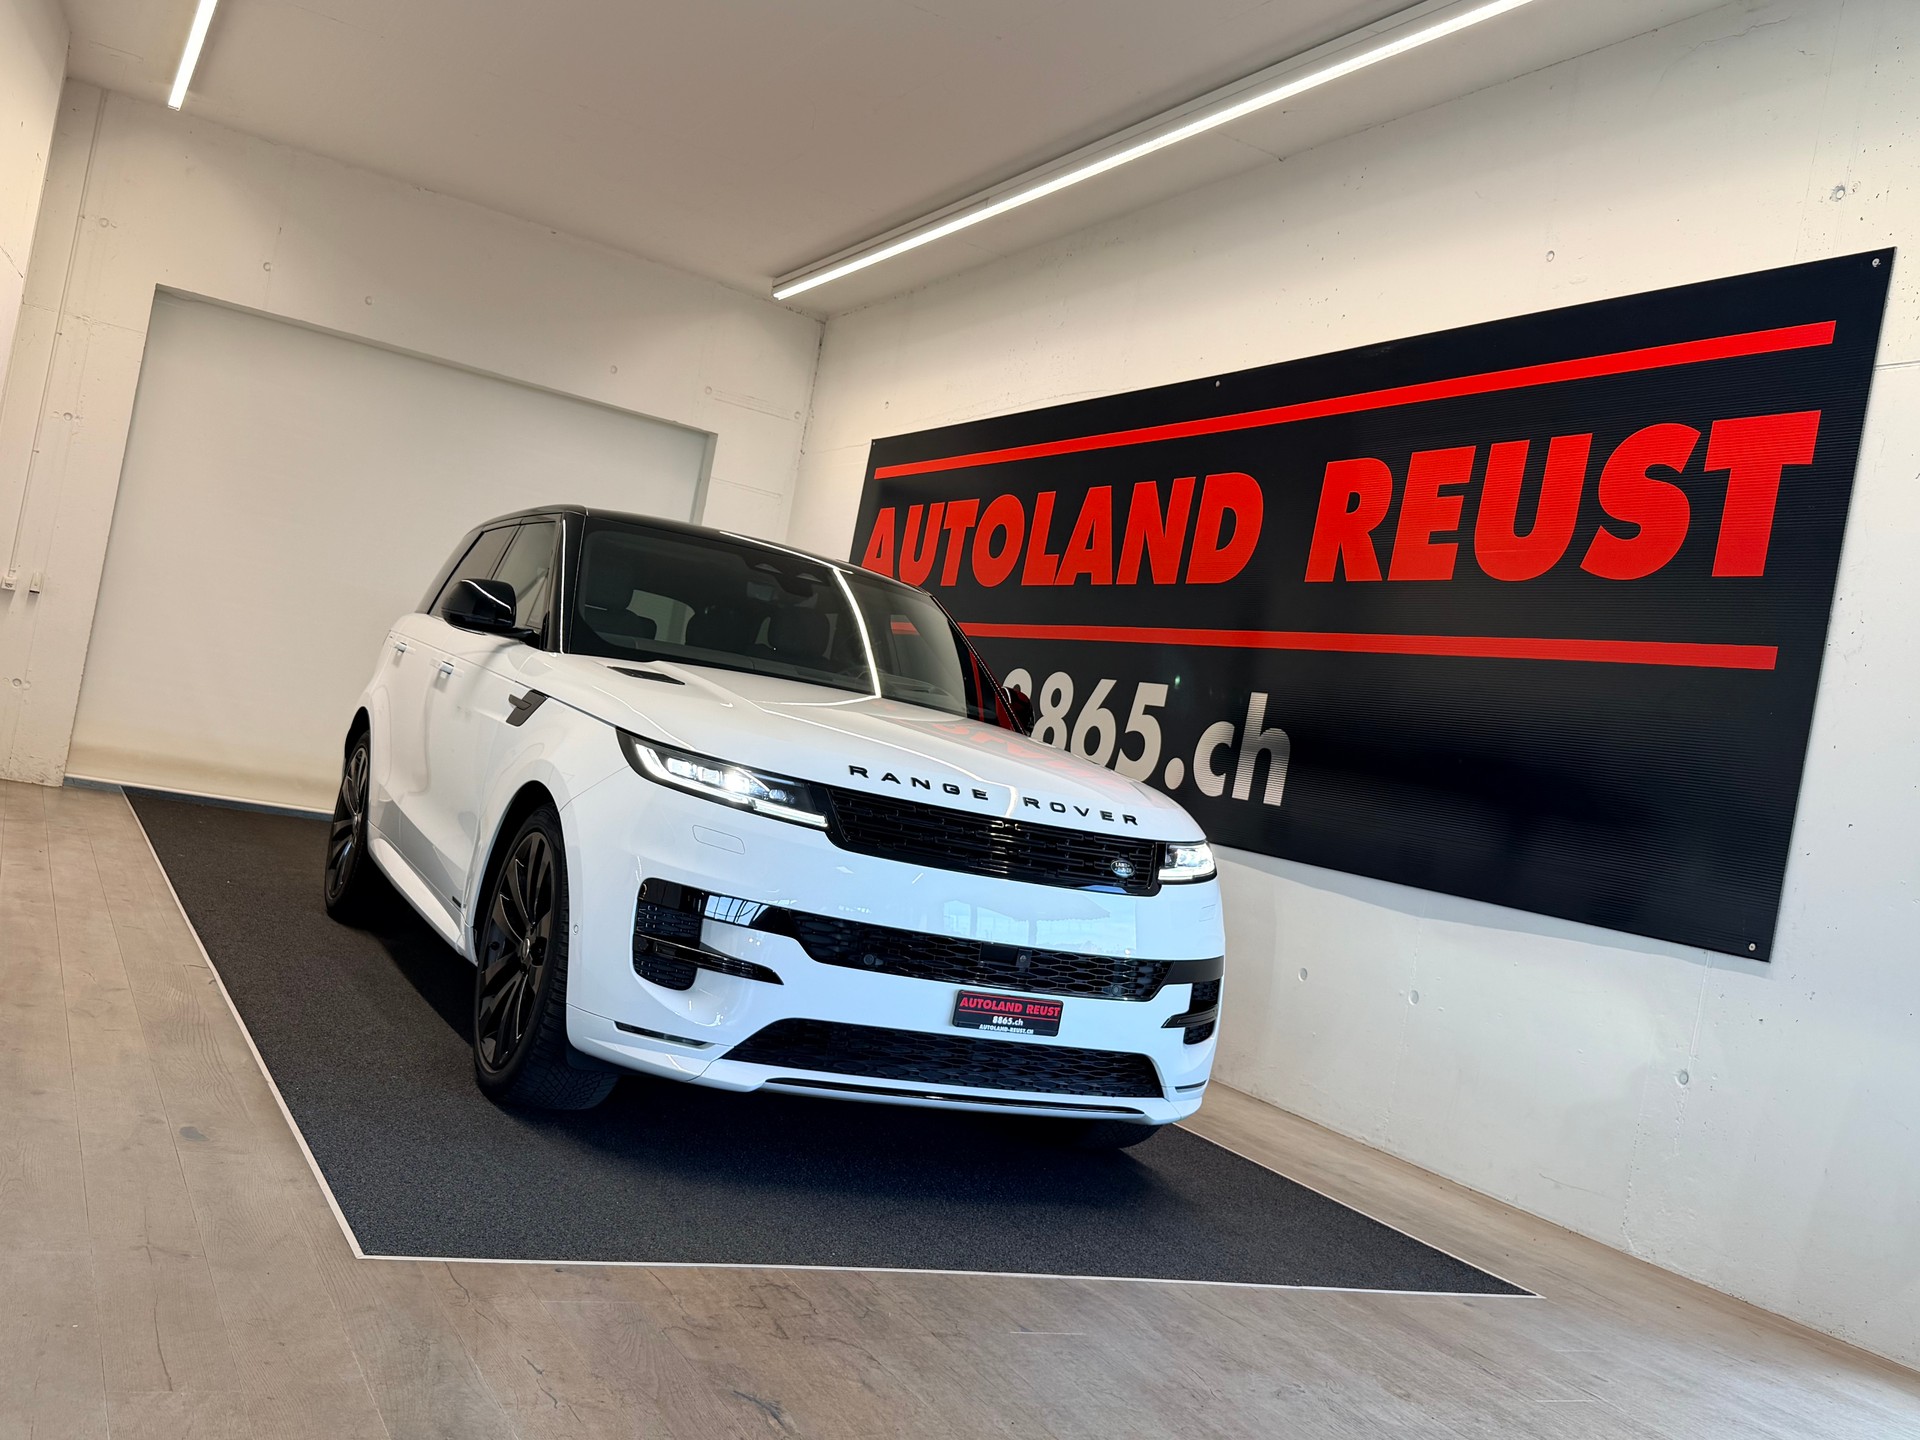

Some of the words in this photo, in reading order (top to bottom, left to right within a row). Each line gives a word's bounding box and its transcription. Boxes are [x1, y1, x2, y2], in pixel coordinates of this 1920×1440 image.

[861, 472, 1264, 587] AUTOLAND
[1304, 409, 1822, 582] REUST
[848, 764, 989, 801] RANGE
[1022, 796, 1139, 826] ROVER
[960, 997, 1023, 1013] AUTOLAND
[1026, 1004, 1061, 1017] REUST
[979, 1024, 1034, 1035] AUTOLAND-REUST.CH
[992, 1016, 1024, 1026] 8865.ch
